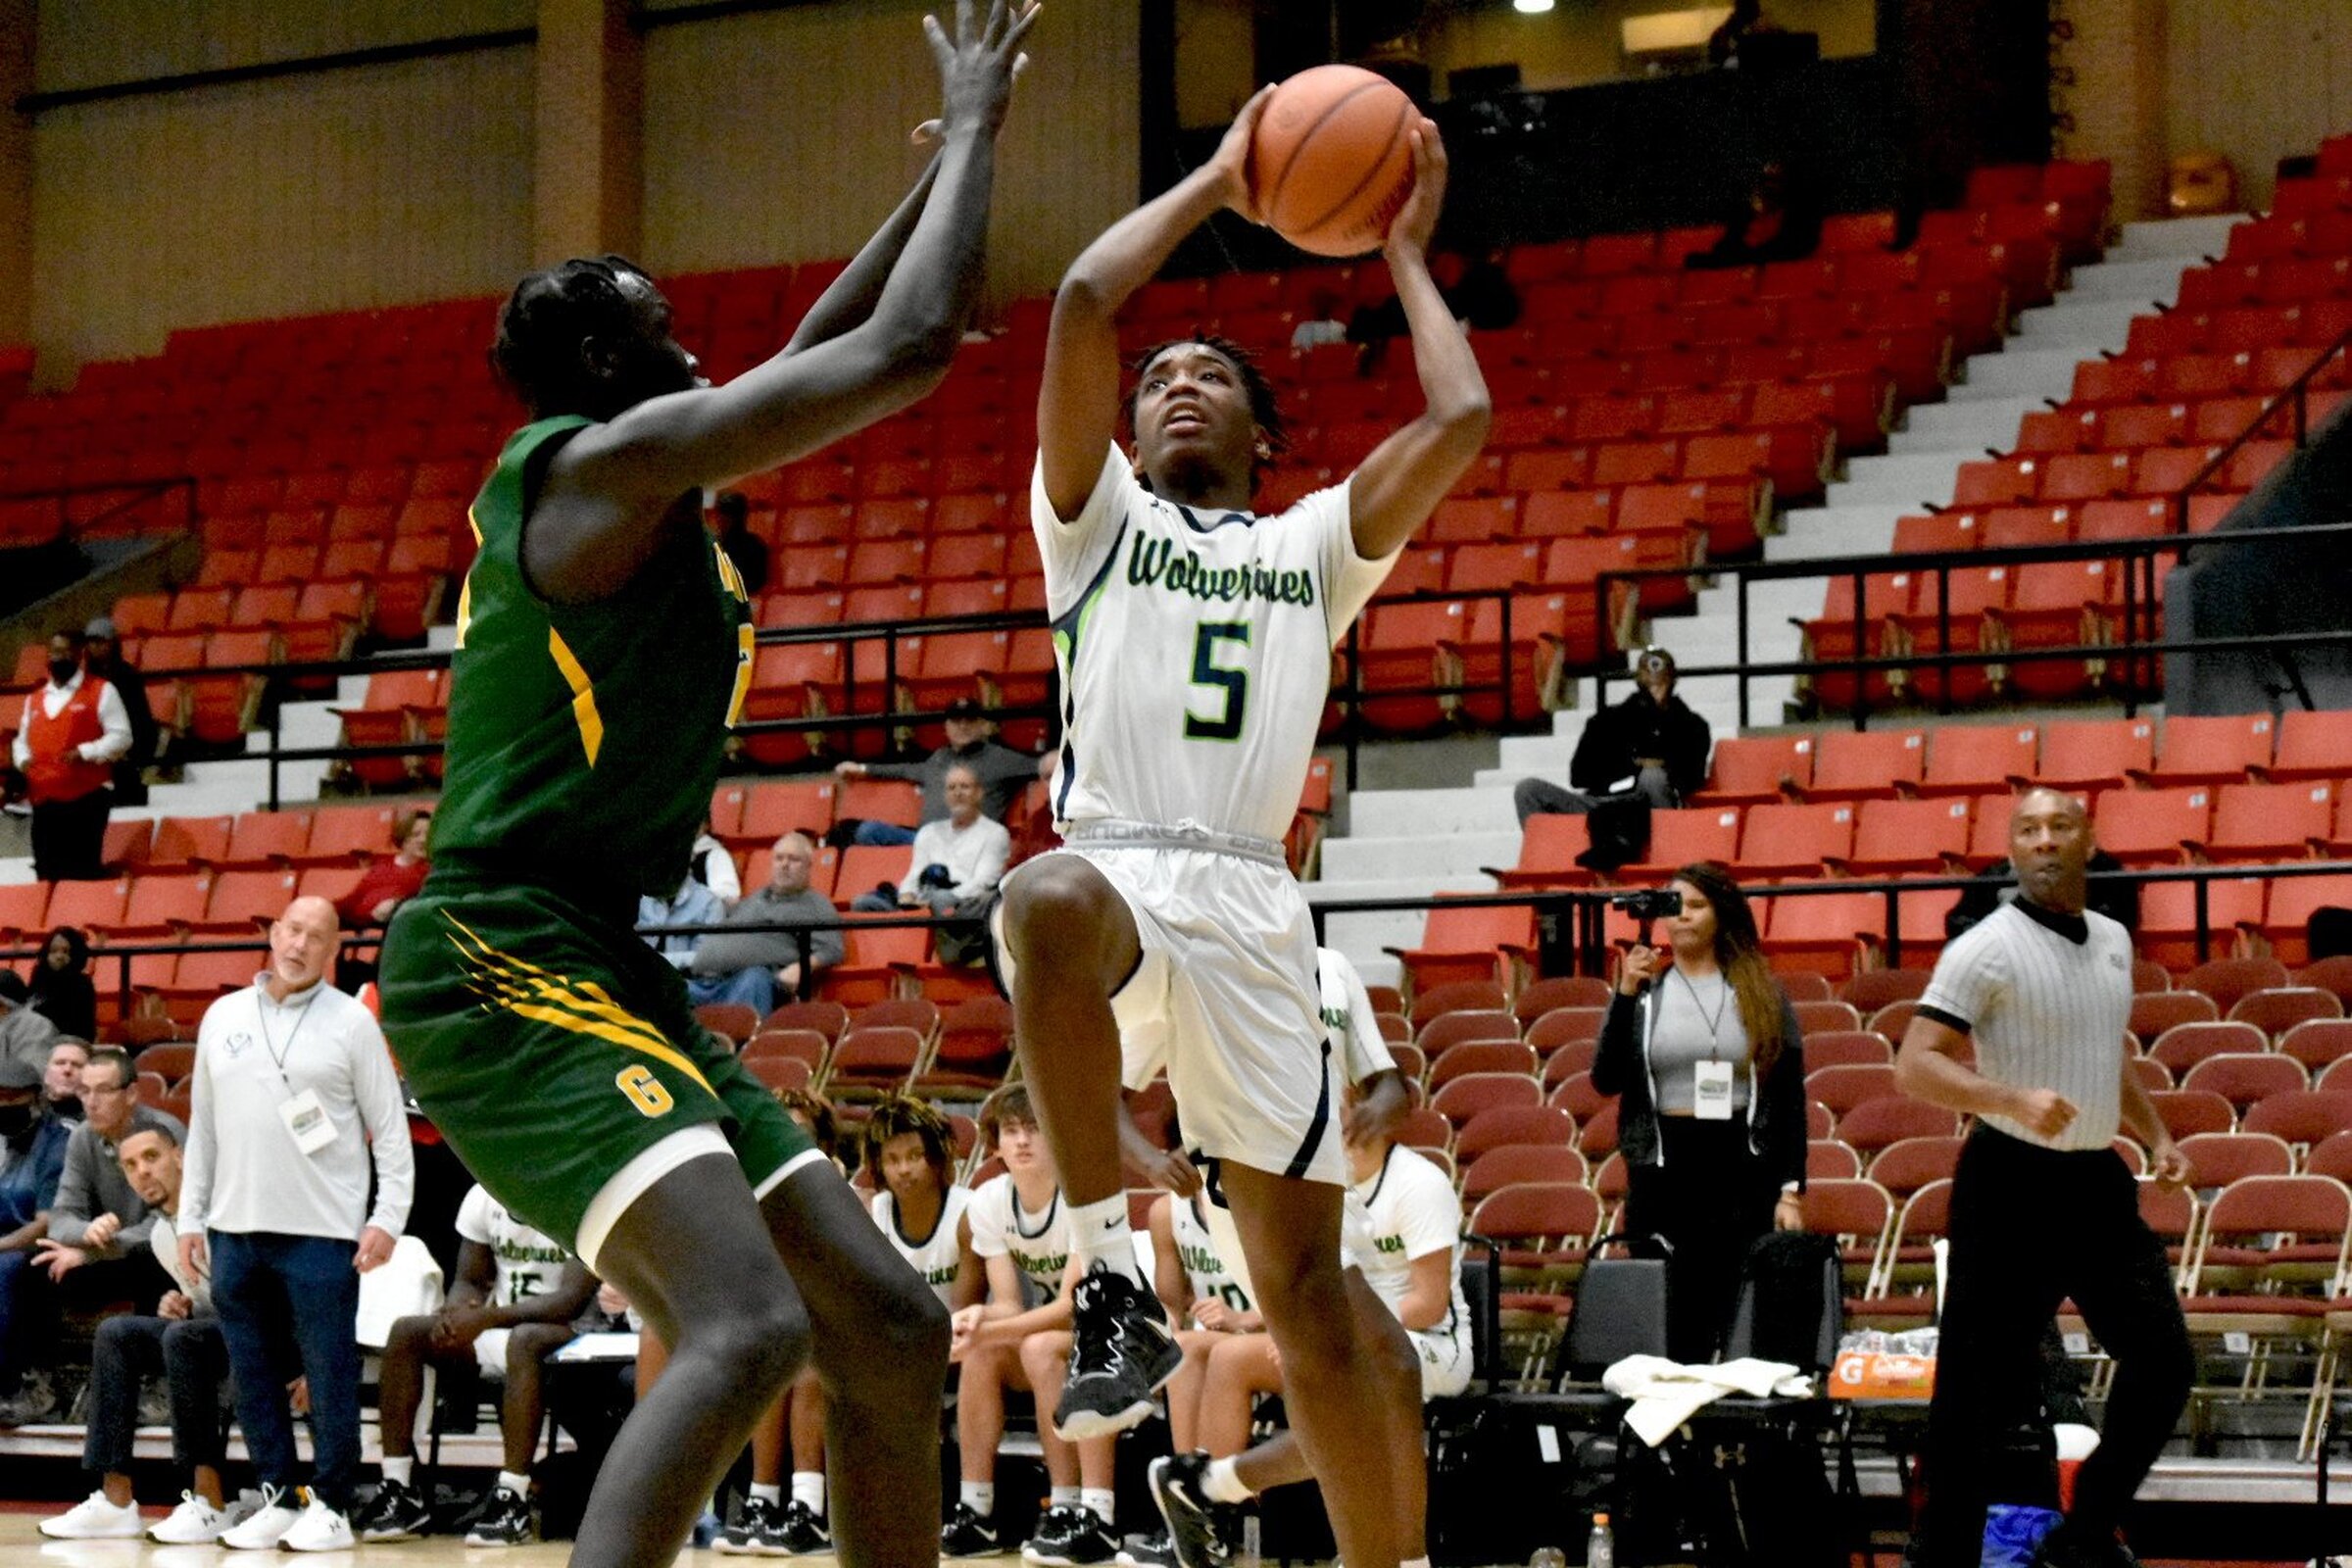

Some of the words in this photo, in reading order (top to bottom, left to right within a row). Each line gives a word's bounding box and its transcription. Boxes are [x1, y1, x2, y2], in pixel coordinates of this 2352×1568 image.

[1127, 529, 1314, 608] Wolverines
[1183, 618, 1252, 744] 5
[615, 1063, 674, 1118] G
[1839, 1357, 1865, 1385] G
